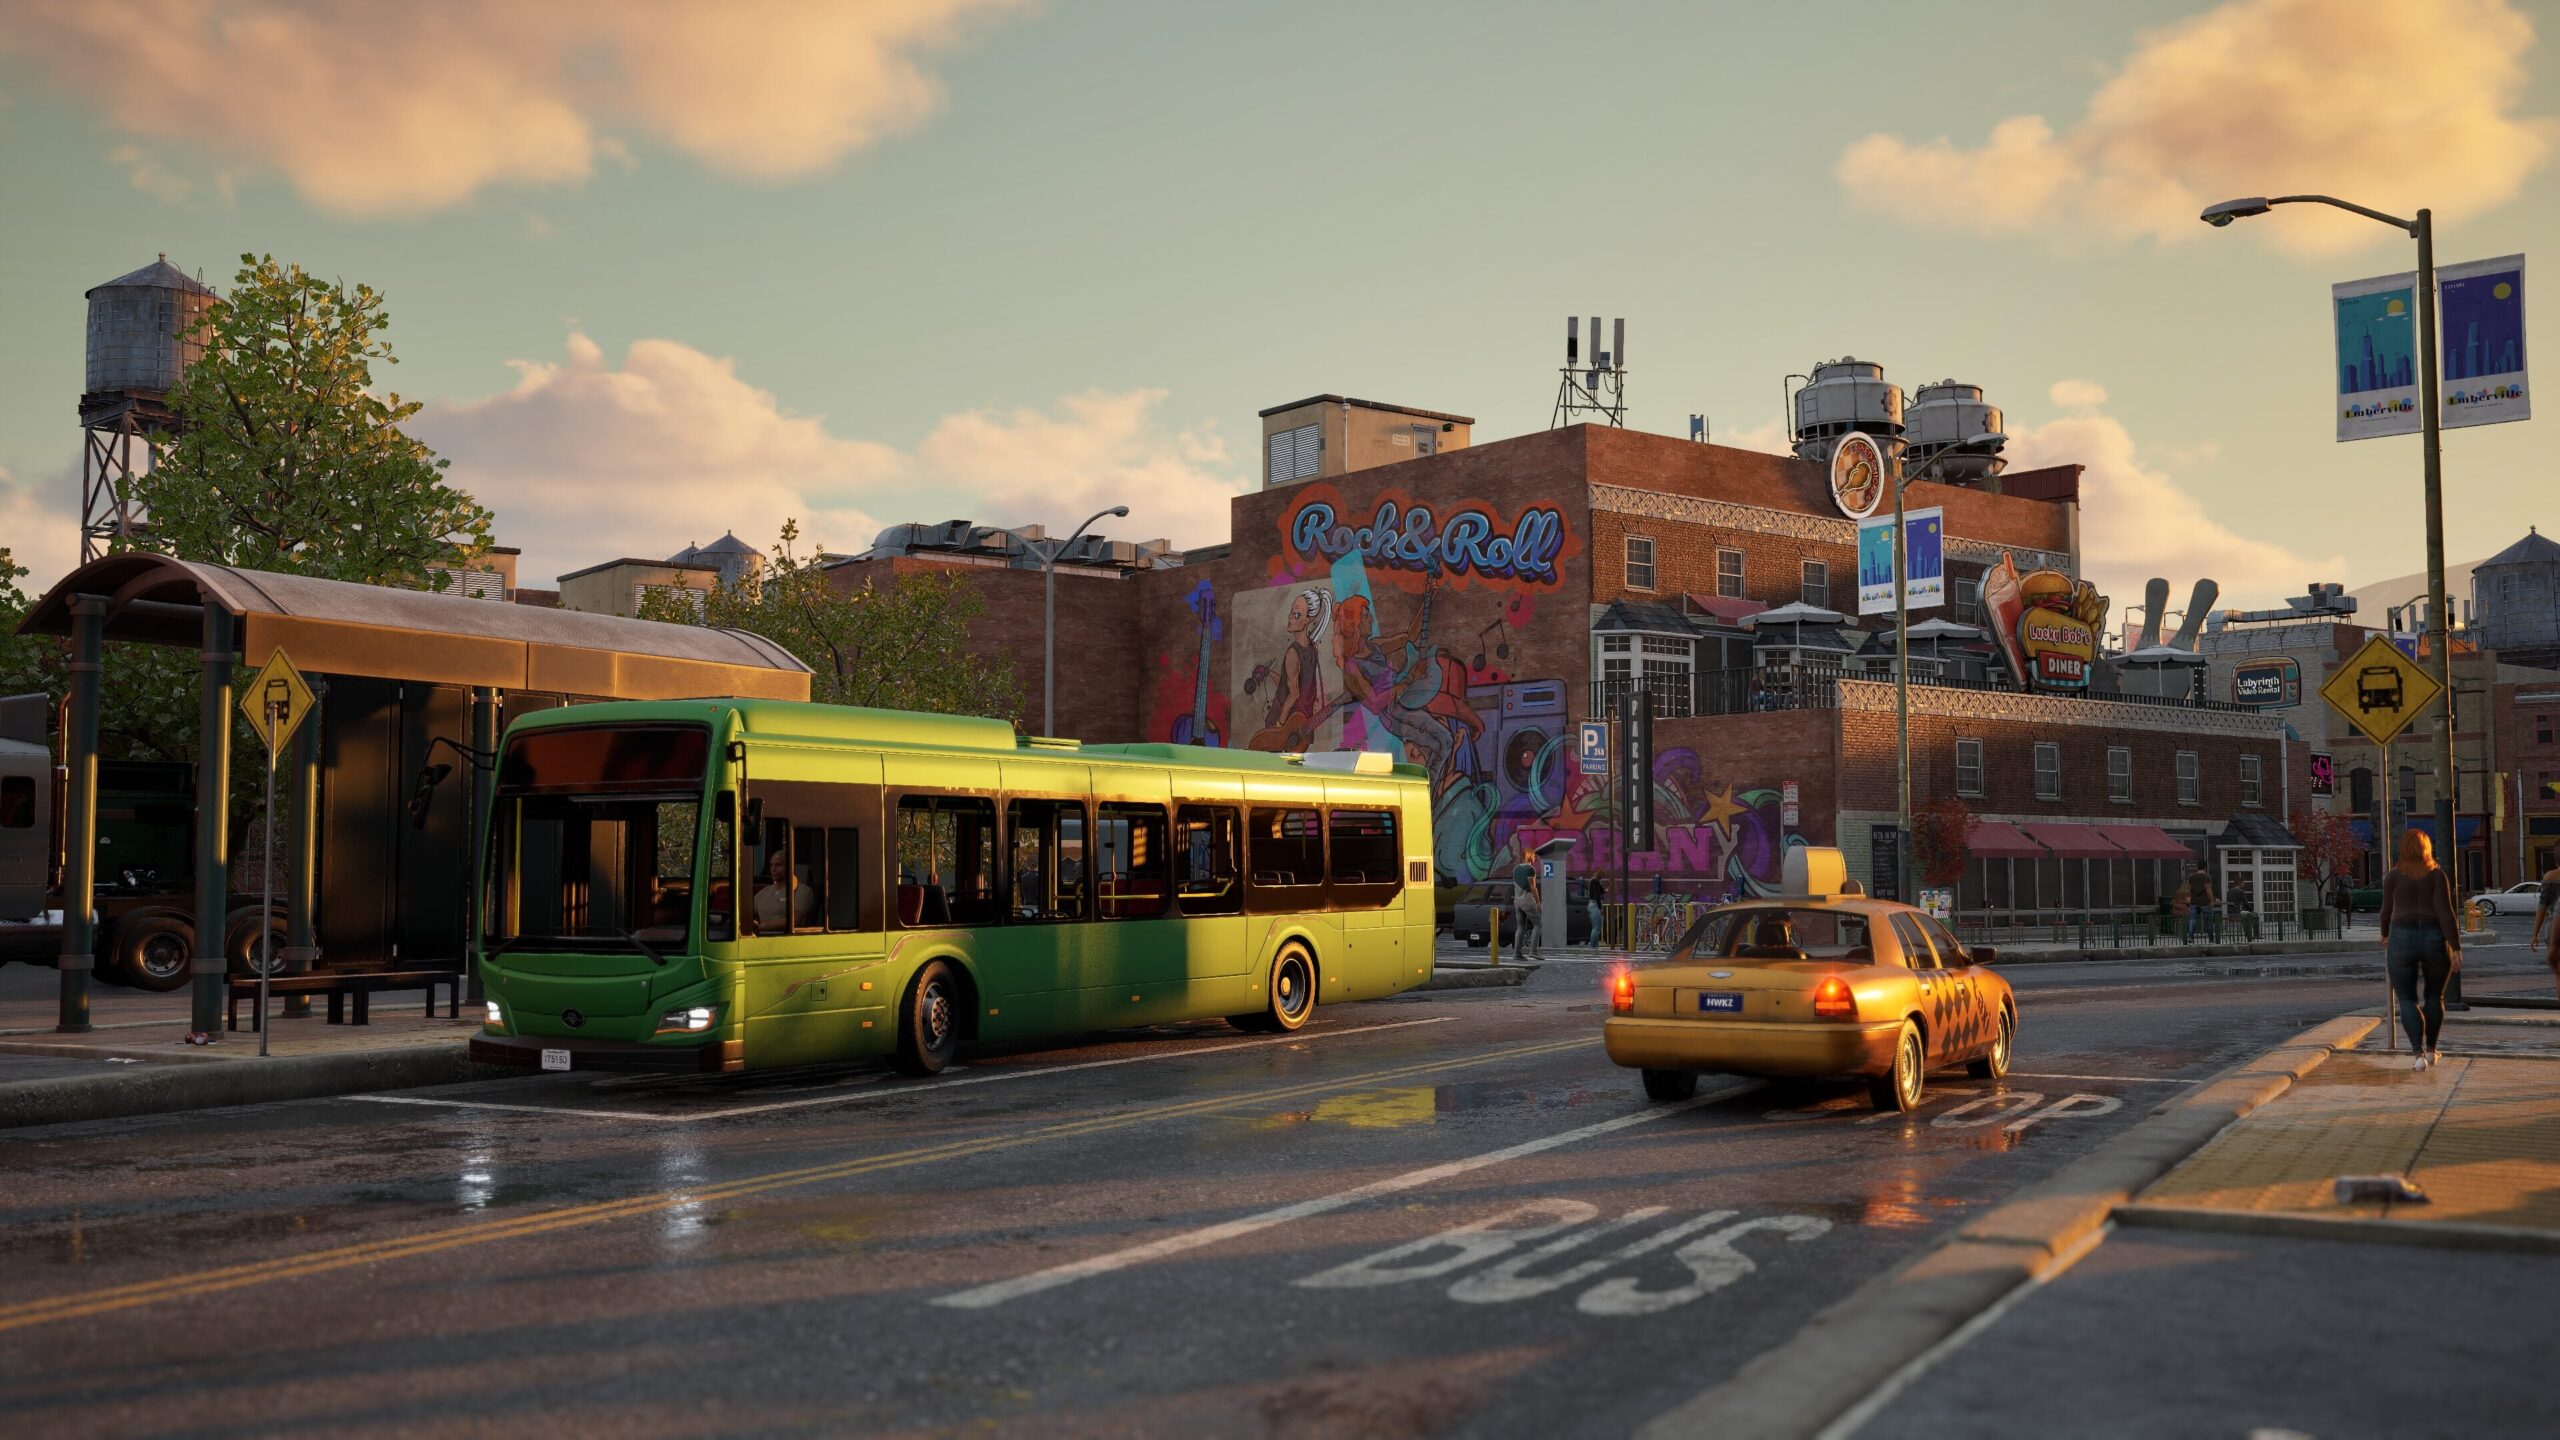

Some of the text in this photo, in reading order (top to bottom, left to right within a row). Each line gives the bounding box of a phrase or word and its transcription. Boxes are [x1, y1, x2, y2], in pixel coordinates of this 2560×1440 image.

[2449, 389, 2523, 406] Emberville
[2345, 402, 2415, 419] Emberville
[2029, 623, 2092, 646] Lucky Bob's
[2048, 657, 2081, 676] DINER
[2237, 676, 2280, 689] Labyrinth
[2238, 686, 2280, 695] Video Rental
[1584, 729, 1599, 756] P
[1583, 763, 1606, 771] PARKING
[1631, 699, 1640, 844] PARKING
[1290, 1198, 1834, 1317] BUS
